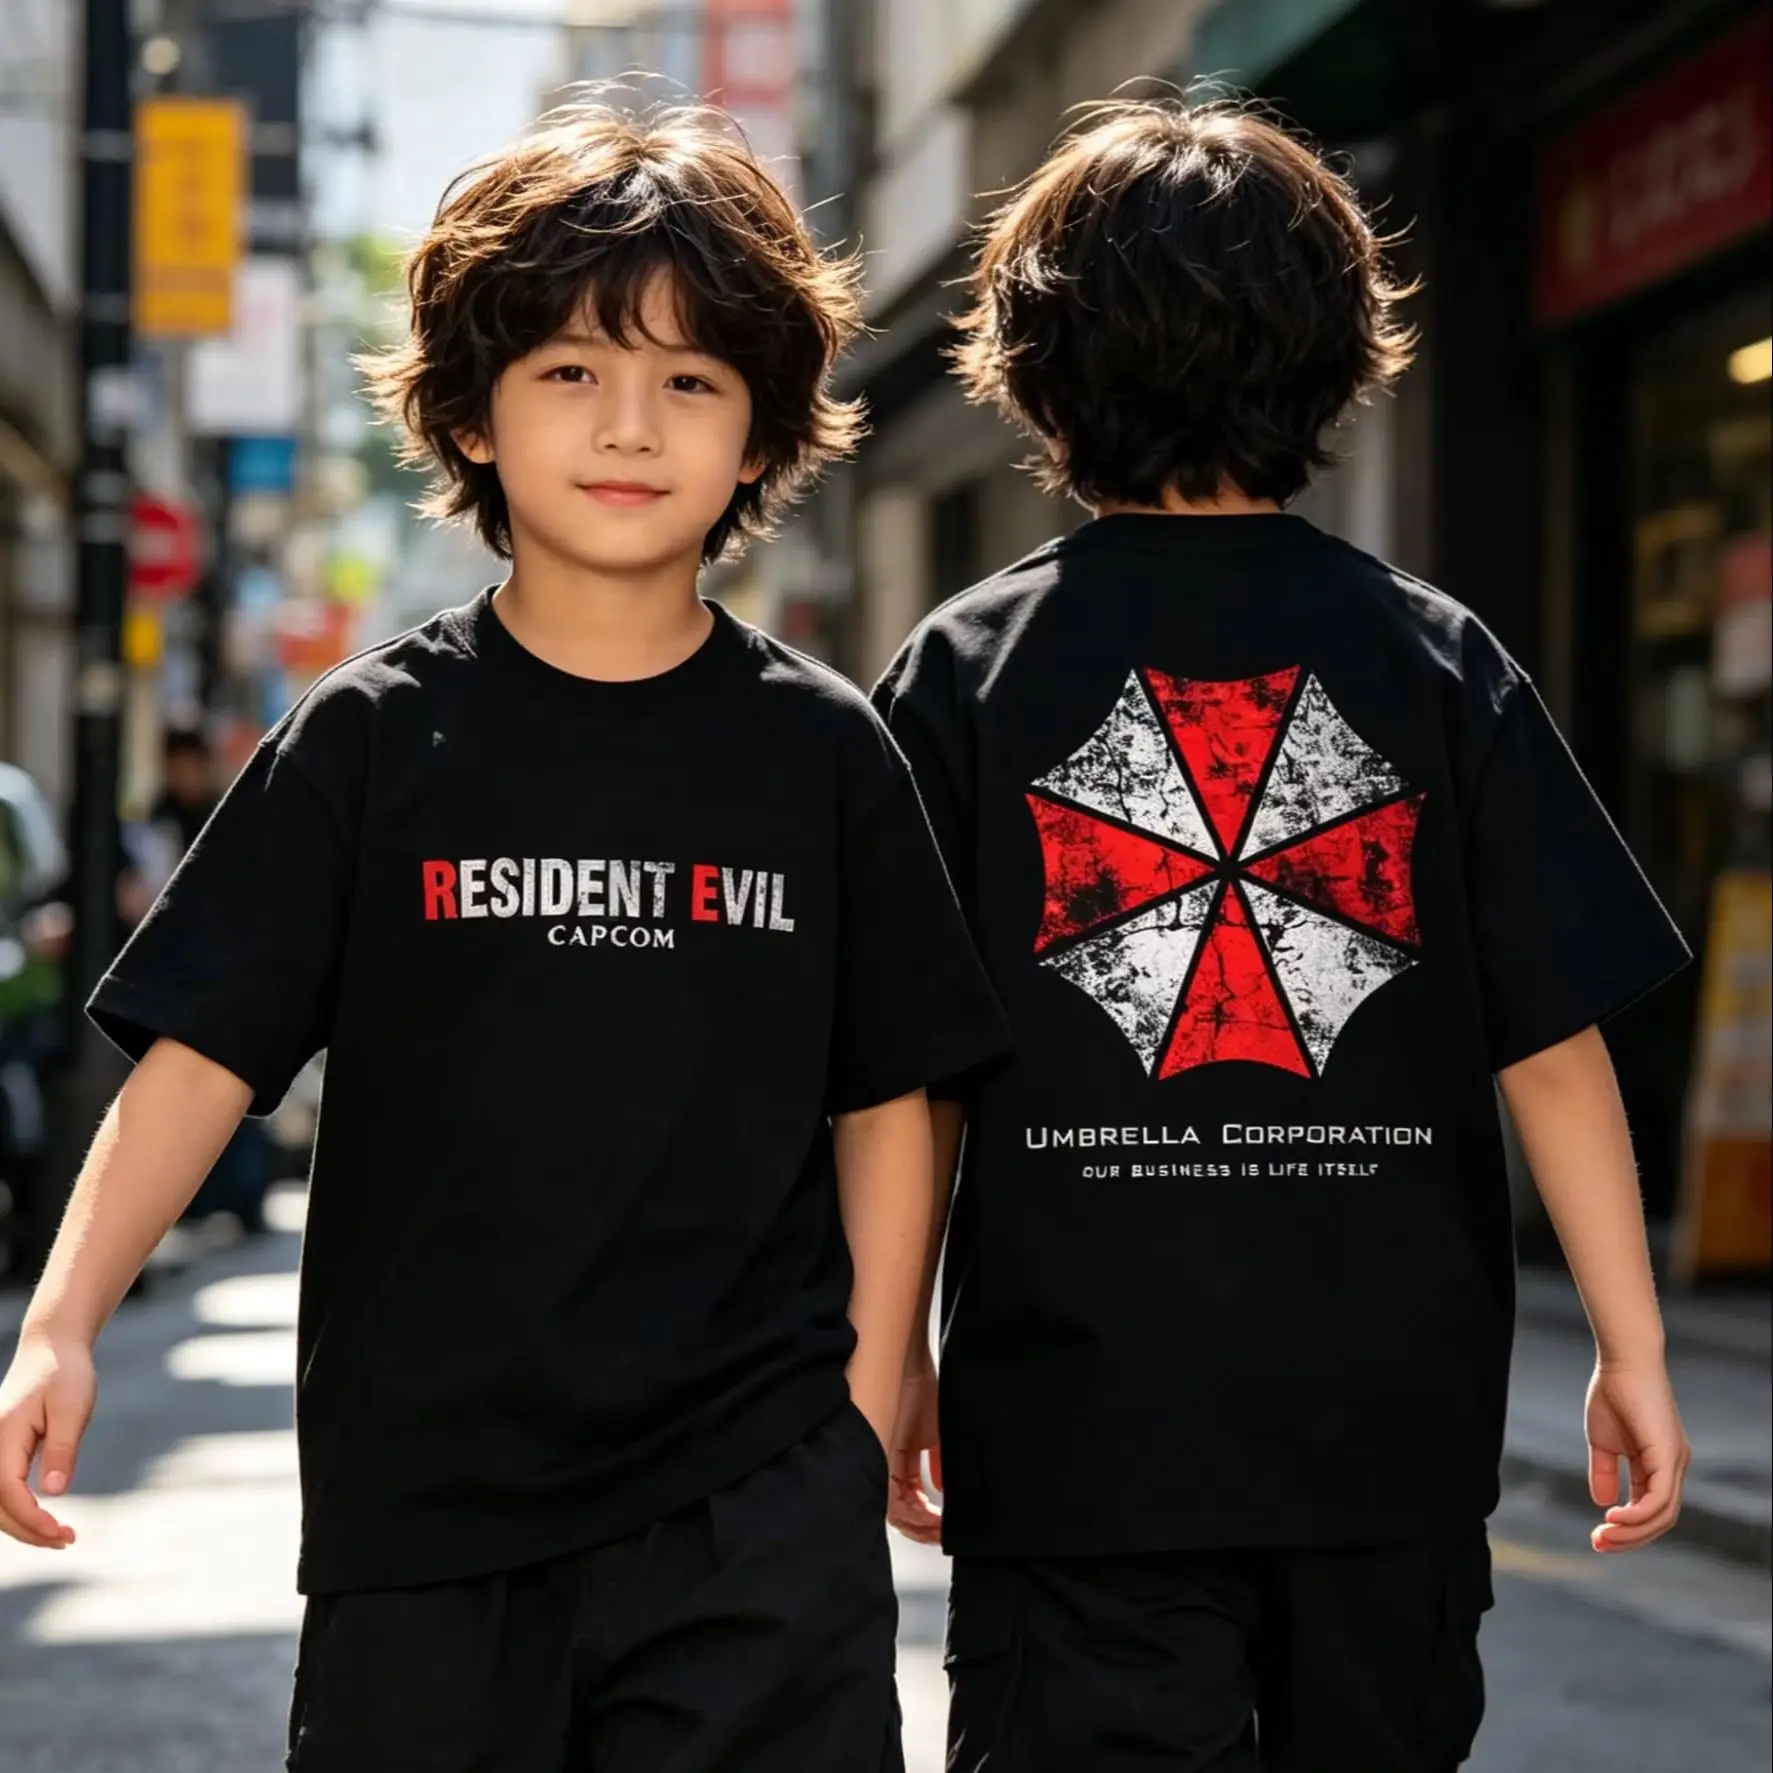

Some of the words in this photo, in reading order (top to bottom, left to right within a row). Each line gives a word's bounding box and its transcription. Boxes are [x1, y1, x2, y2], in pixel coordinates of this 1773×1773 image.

[422, 857, 676, 920] RESIDENT
[690, 863, 795, 932] EVIL
[547, 925, 675, 949] CAPCOM
[1026, 1125, 1201, 1149] UMBRELLA
[1222, 1123, 1432, 1146] CORPORATION
[1081, 1164, 1121, 1180] OUR
[1130, 1163, 1232, 1179] BUSINESS
[1240, 1162, 1261, 1178] IS
[1268, 1162, 1310, 1178] LIFE
[1317, 1162, 1380, 1178] ITSELF
